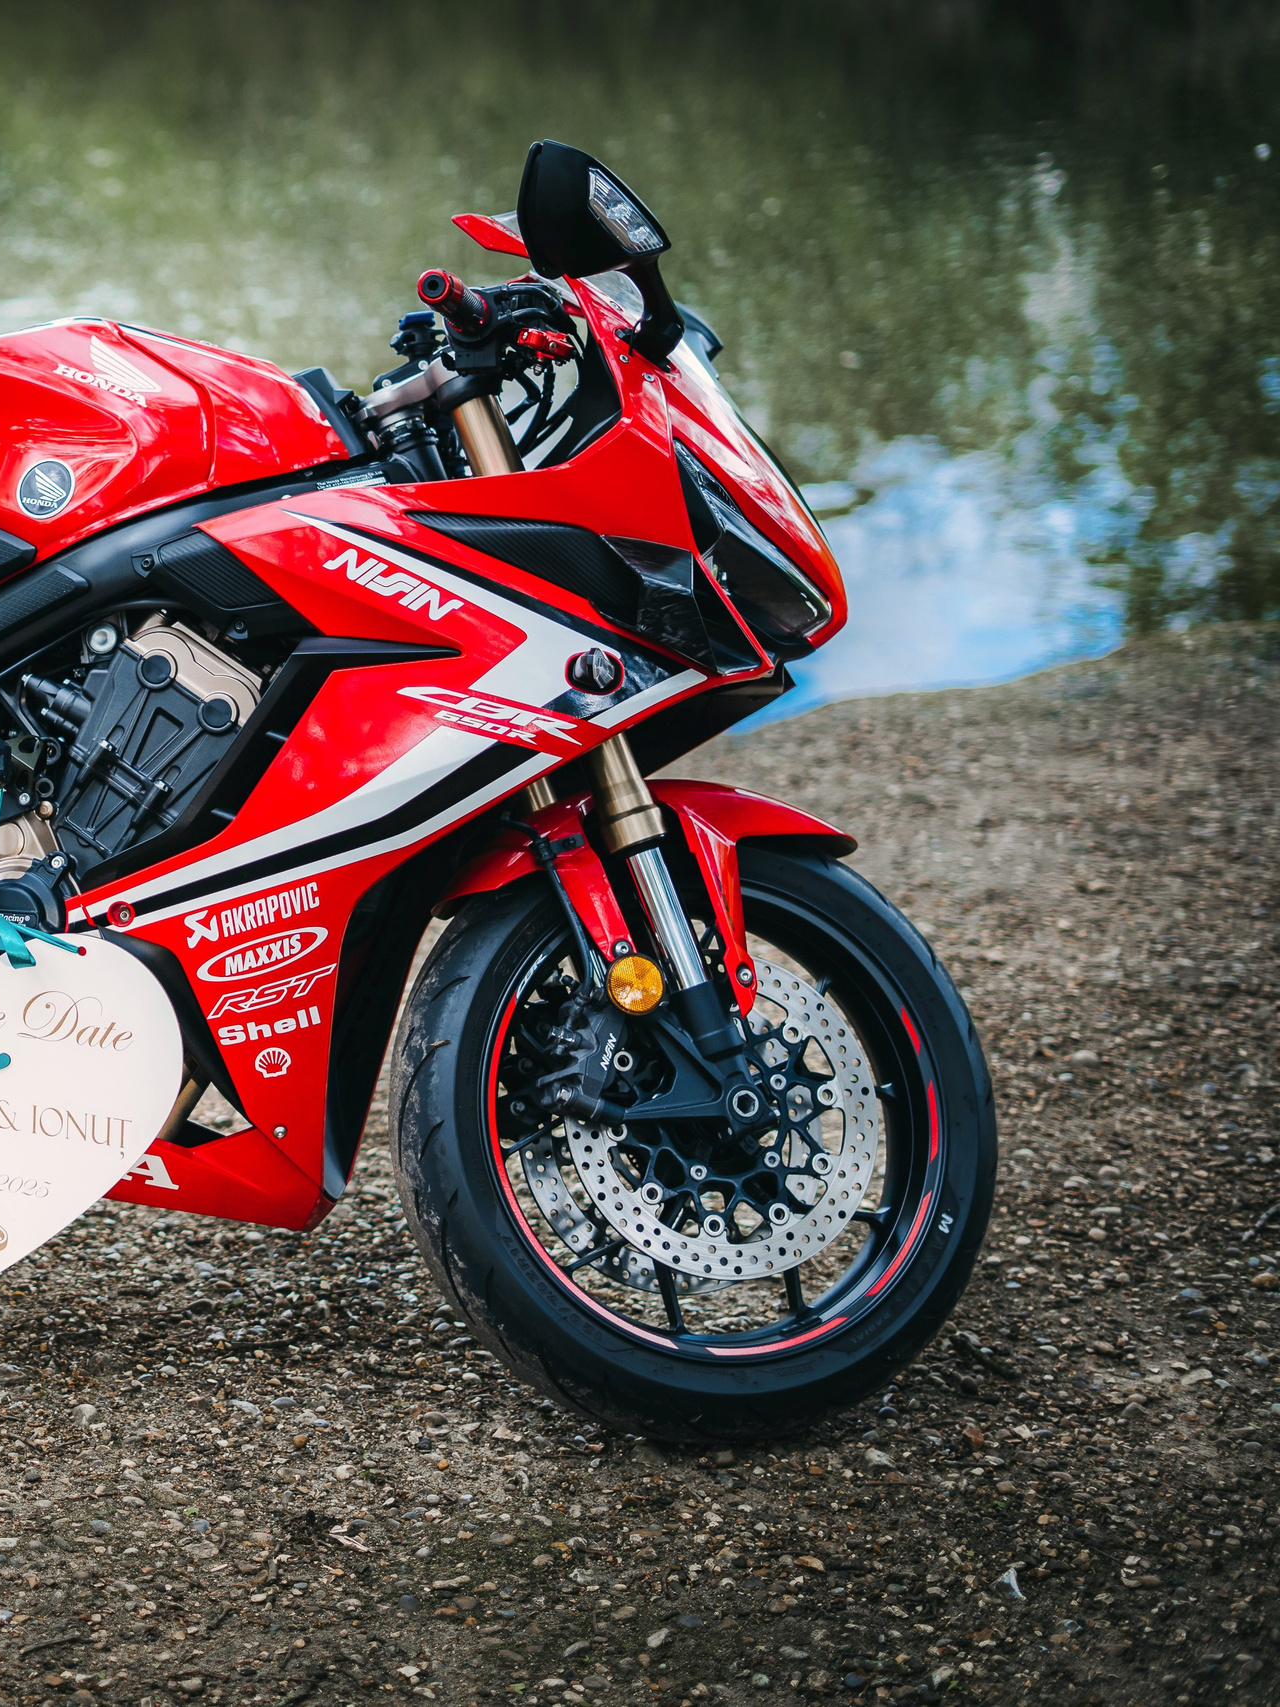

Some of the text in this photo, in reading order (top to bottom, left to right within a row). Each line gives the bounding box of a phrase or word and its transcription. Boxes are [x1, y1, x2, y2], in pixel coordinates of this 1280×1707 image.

[53, 363, 148, 408] HONDA
[22, 496, 59, 508] HONDA
[396, 686, 583, 746] CBR
[434, 710, 538, 746] 650R
[220, 881, 320, 938] AKRAPOVIC
[225, 933, 302, 977] MAXXIS
[207, 962, 338, 1020] RST
[17, 990, 134, 1052] Date
[217, 1005, 322, 1046] Shell
